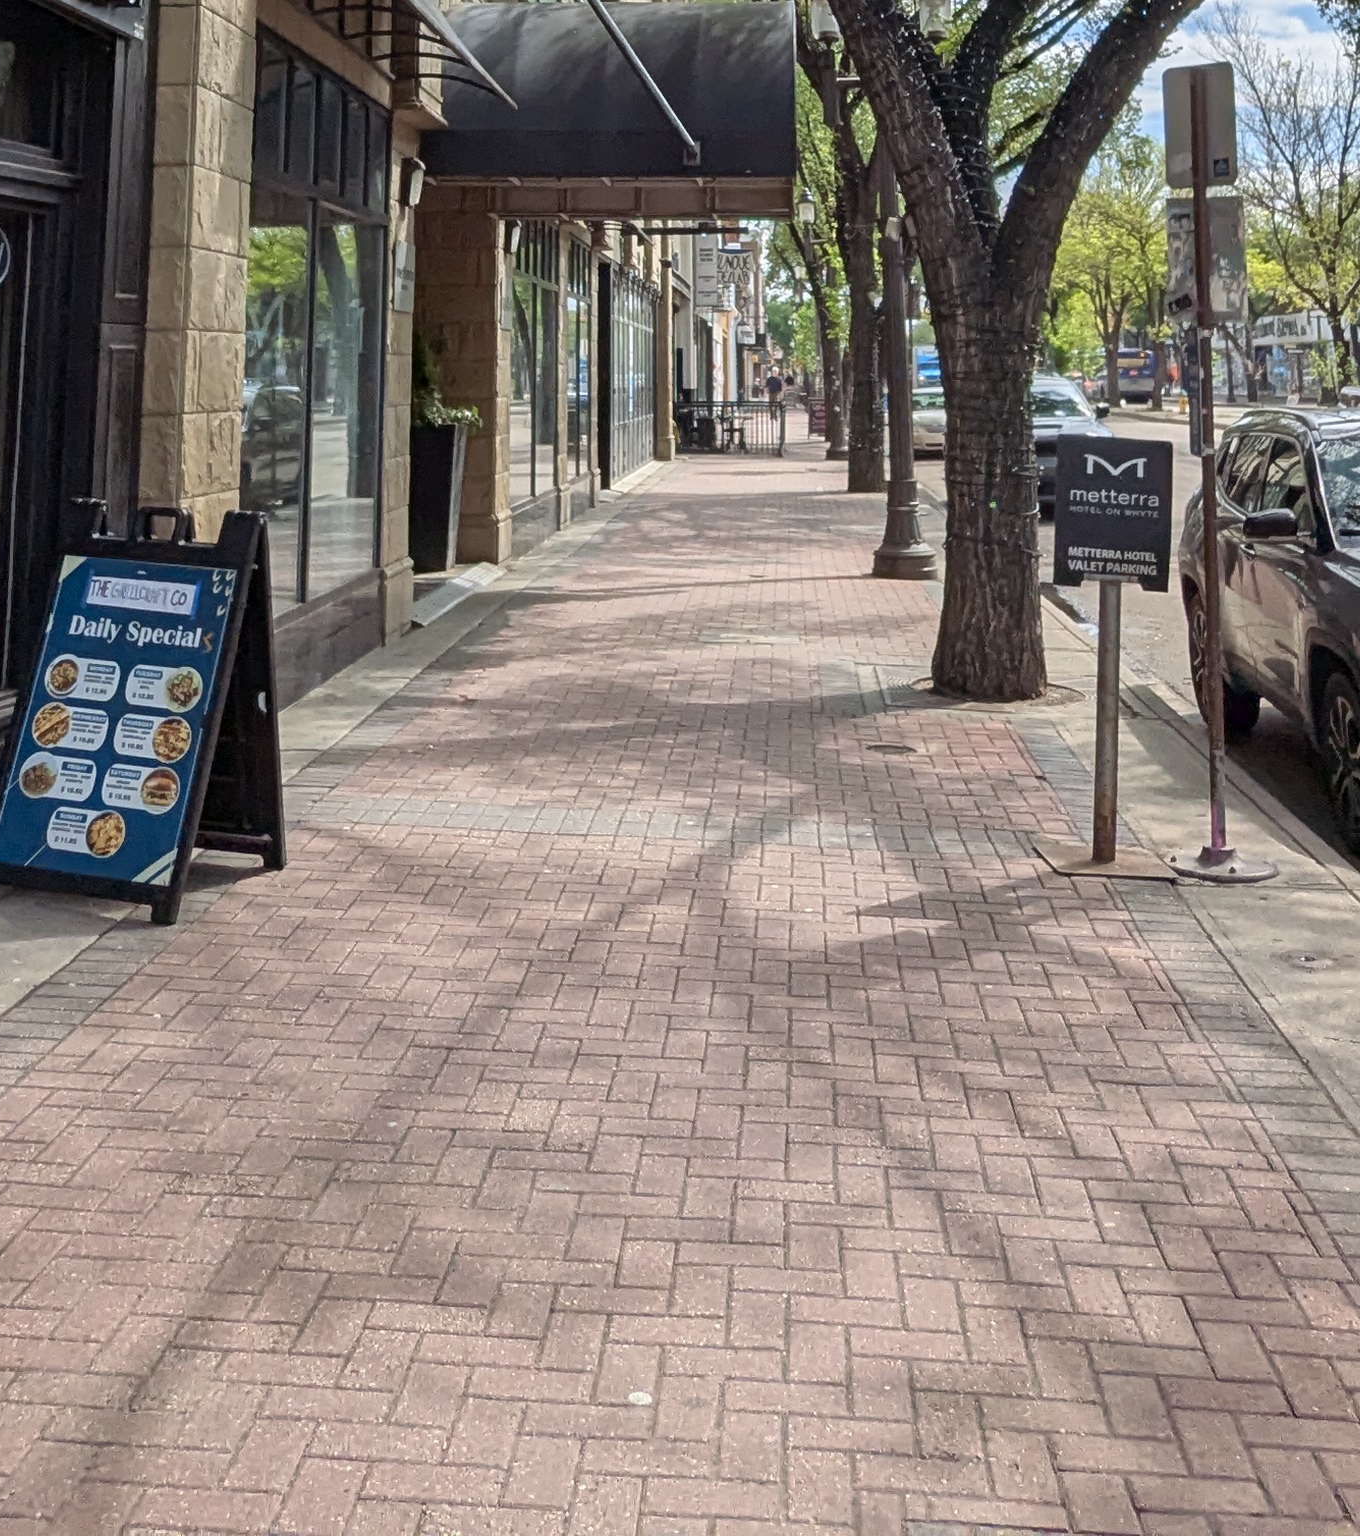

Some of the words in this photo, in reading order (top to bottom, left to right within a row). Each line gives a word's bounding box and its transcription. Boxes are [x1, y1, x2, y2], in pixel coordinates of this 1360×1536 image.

[1070, 489, 1160, 507] metterra
[1069, 506, 1102, 515] HOTEL
[1105, 508, 1121, 516] ON
[1124, 509, 1159, 518] WHYTE
[1068, 546, 1122, 561] METTERRA
[1124, 550, 1157, 562] HOTEL
[1068, 560, 1103, 572] VALET
[1106, 561, 1158, 576] PARKING
[90, 577, 112, 598] THE
[170, 590, 188, 606] CO
[68, 615, 122, 644] Daily
